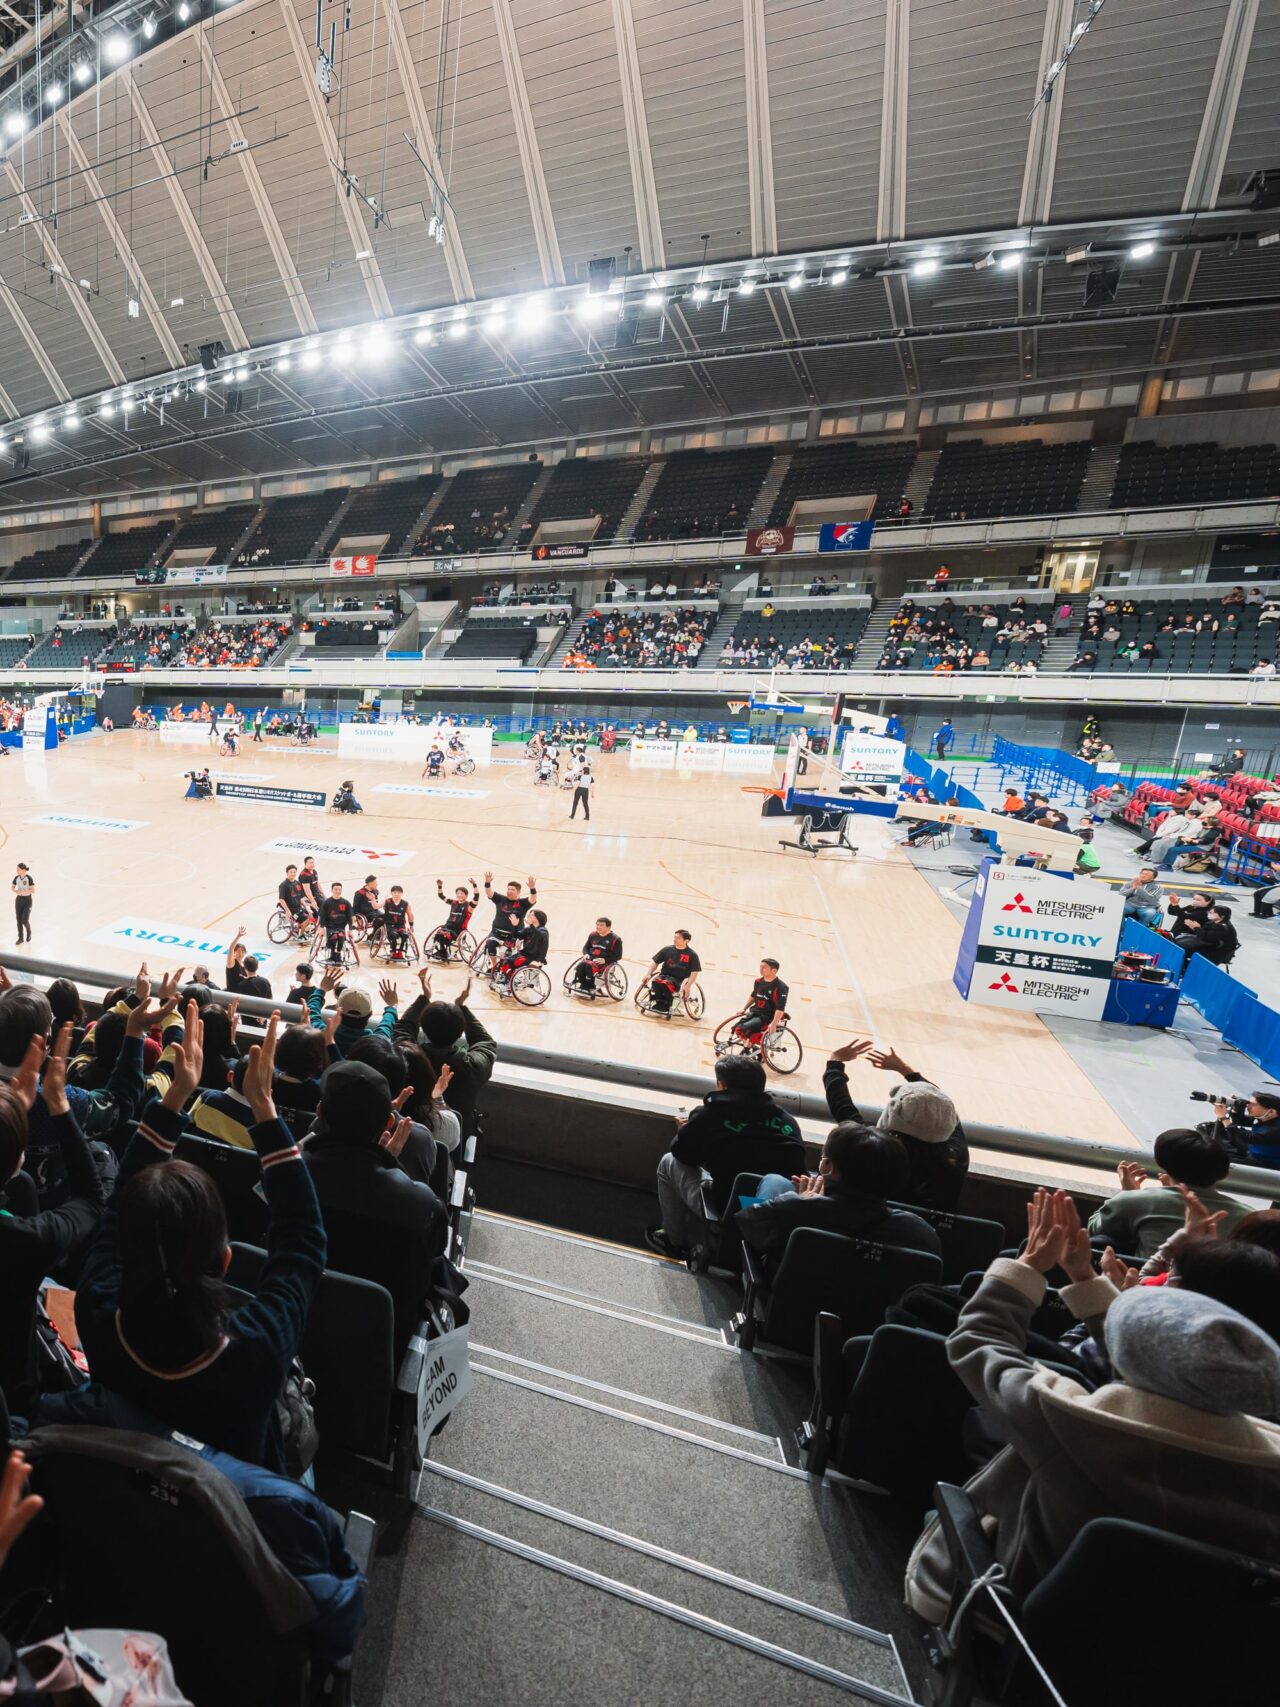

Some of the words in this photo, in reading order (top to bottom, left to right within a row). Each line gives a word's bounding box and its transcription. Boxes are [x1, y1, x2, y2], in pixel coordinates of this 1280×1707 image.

[355, 729, 394, 737] SUNTORY
[851, 747, 899, 755] SUNTORY
[1036, 907, 1094, 920] ELECTRIC
[1037, 899, 1105, 914] MITSUBISHI
[114, 928, 271, 961] SNTORY
[992, 925, 1103, 948] SUNTORY
[994, 950, 1050, 969] 天皇杯
[1022, 987, 1079, 1002] ELECTRIC
[1023, 980, 1090, 996] MITSUBISHI
[722, 1116, 794, 1137] CICS
[421, 1371, 458, 1431] BEYOND
